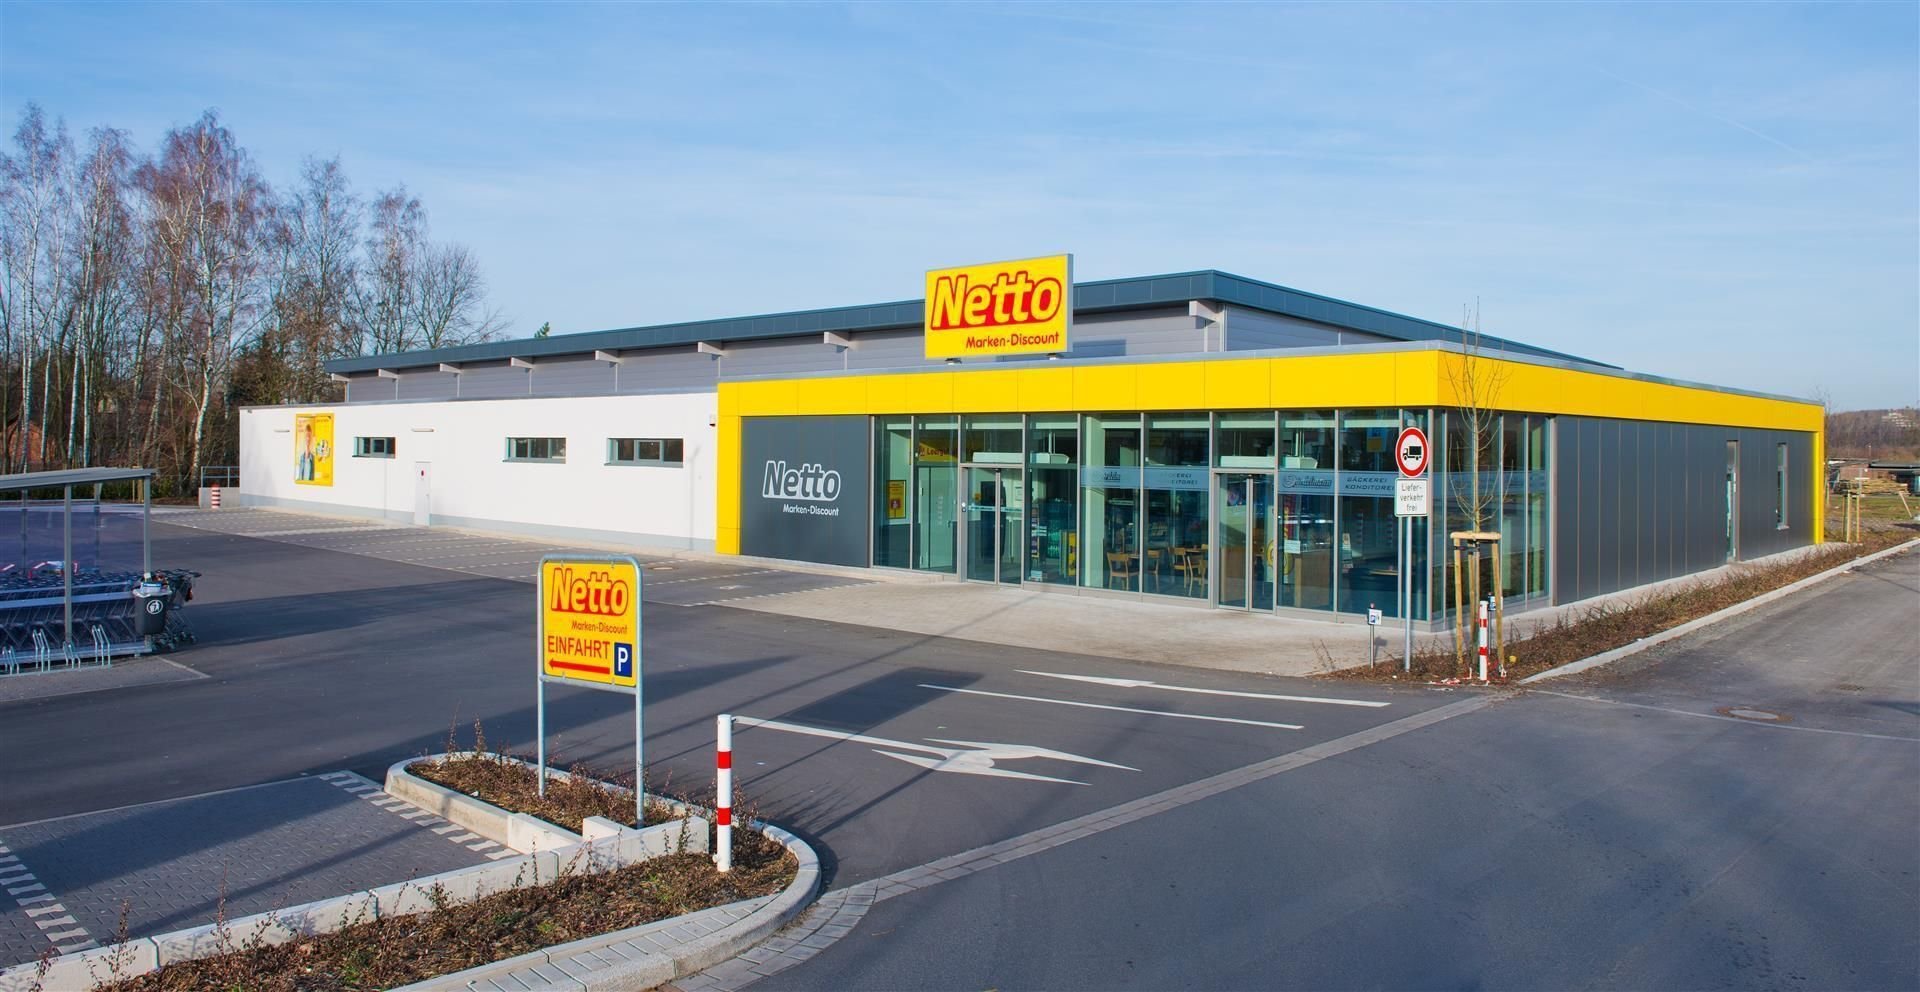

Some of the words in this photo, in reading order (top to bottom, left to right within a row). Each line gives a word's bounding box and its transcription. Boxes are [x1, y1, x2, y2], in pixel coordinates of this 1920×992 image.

[930, 271, 1062, 330] Netto
[966, 331, 1059, 348] Marken-Discount
[763, 460, 841, 501] Netto
[1401, 482, 1422, 492] Liefer-
[1400, 492, 1423, 502] verkehr
[783, 504, 839, 516] Marken-Discount
[1406, 503, 1418, 512] frei
[551, 567, 629, 616] Netto
[571, 620, 628, 635] Marken-Discount
[547, 635, 610, 660] EINFAHRT
[618, 646, 628, 673] P
